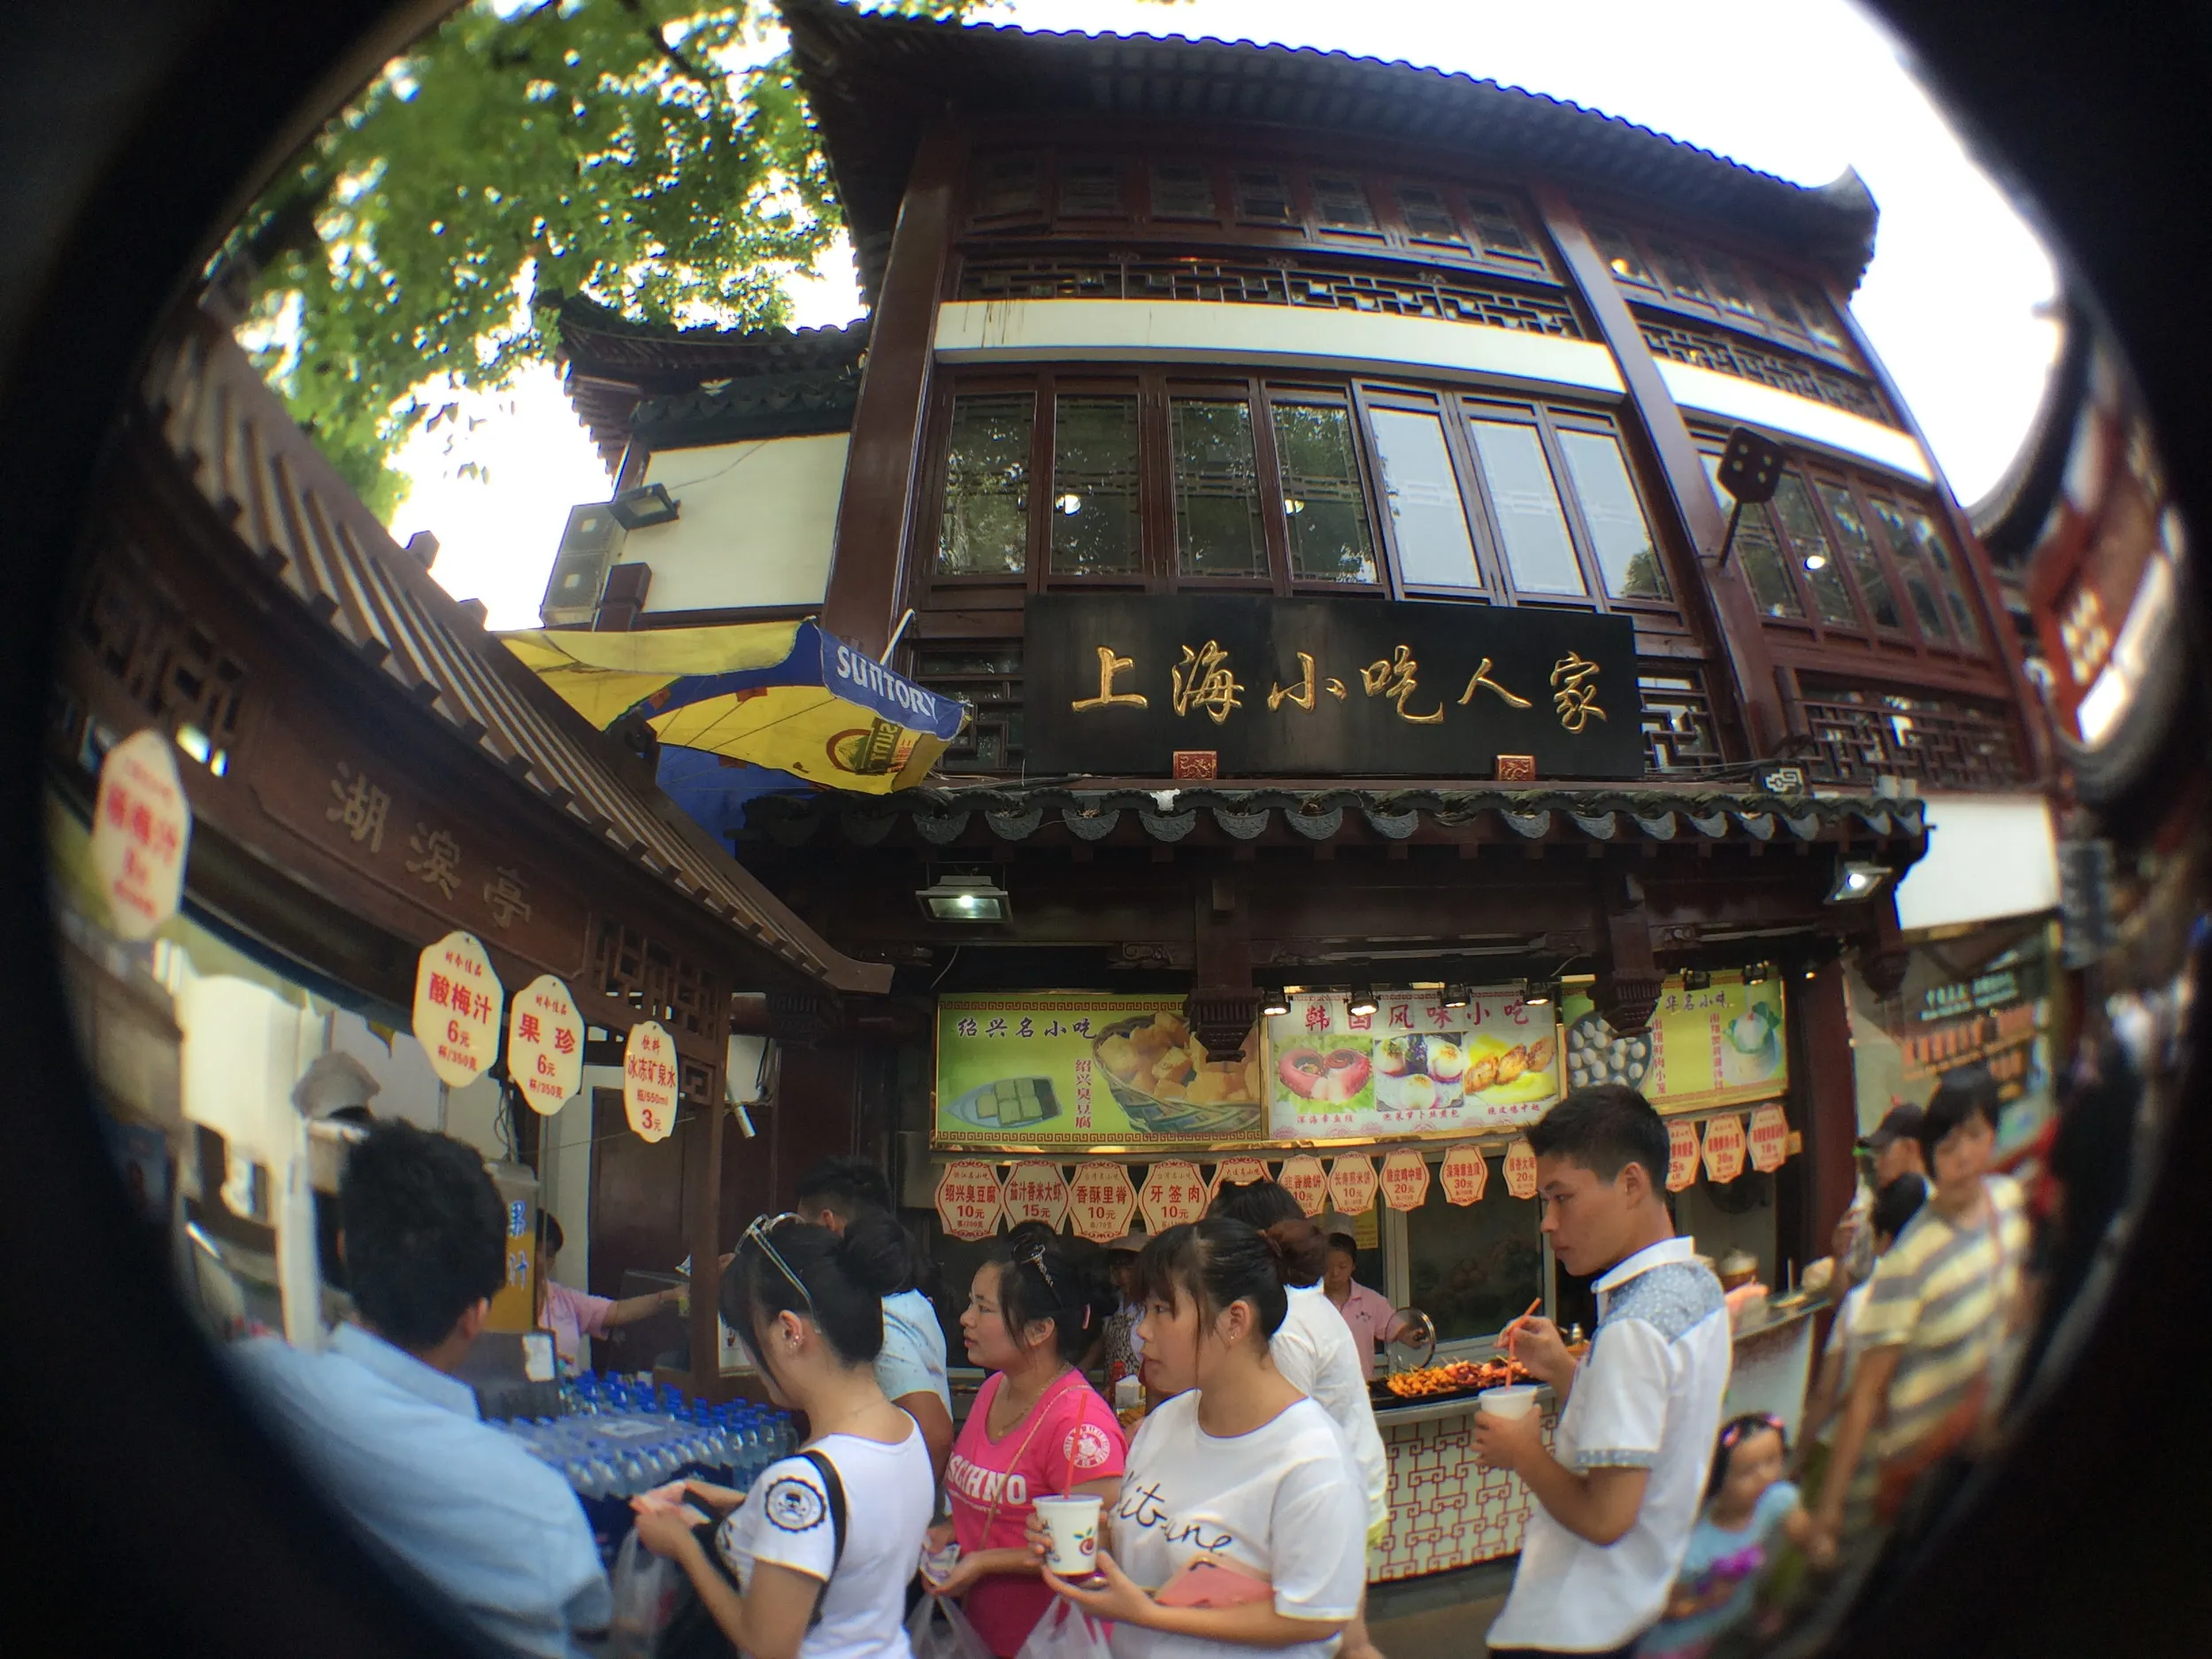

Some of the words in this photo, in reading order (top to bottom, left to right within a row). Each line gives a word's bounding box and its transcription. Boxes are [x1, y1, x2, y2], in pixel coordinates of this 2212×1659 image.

[836, 644, 939, 725] SUNTORY
[1071, 639, 1609, 735] 上海小吃人家
[326, 760, 532, 928] 湖滨亭
[444, 950, 483, 978] 时令佳品
[427, 971, 493, 1025] 酸梅汁
[956, 1015, 1099, 1041] 绍兴名小吃
[1304, 999, 1530, 1033] 韩国风味小吃
[446, 1019, 471, 1048] 6元
[518, 1012, 576, 1056] 果珍
[536, 1053, 556, 1077] 6元
[1074, 1057, 1093, 1130] 绍兴臭豆腐
[641, 1108, 663, 1133] 3元
[944, 1184, 997, 1204] 绍兴臭豆腐
[1076, 1185, 1128, 1204] 香酥里脊
[1149, 1184, 1201, 1204] 牙签肉
[1343, 1187, 1363, 1198] 10元
[1394, 1184, 1416, 1194] 20元
[1454, 1179, 1473, 1189] 30元
[956, 1205, 986, 1219] 10元
[1022, 1203, 1051, 1218] 15元
[1087, 1206, 1117, 1220] 10元
[1161, 1206, 1190, 1220] 10元
